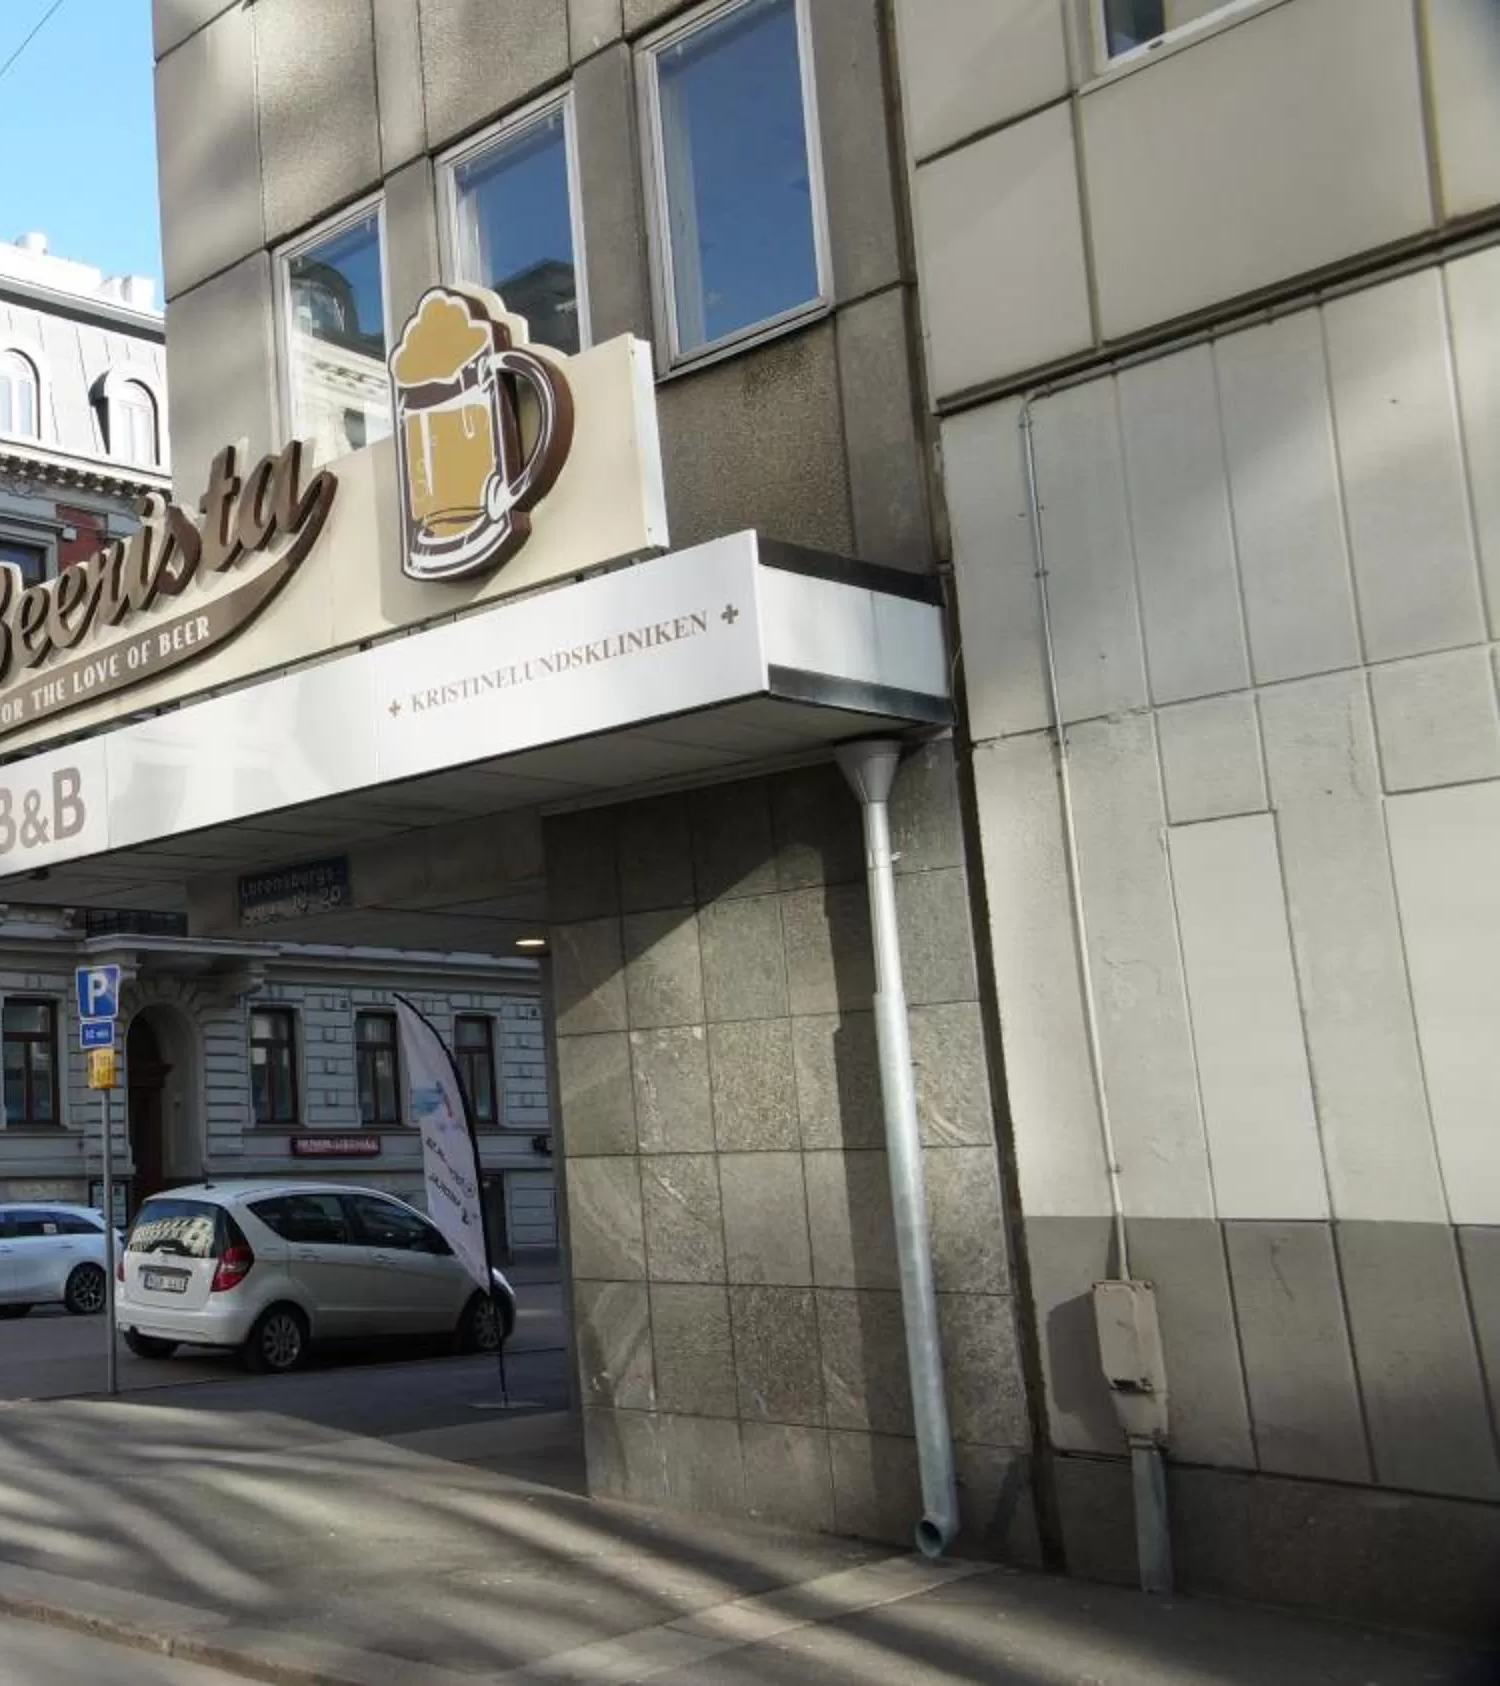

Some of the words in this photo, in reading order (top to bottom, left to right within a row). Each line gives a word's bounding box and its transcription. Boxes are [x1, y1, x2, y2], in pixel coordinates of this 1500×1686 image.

[32, 678, 67, 709] THE
[72, 656, 121, 693] LOVE
[127, 641, 151, 669] OF
[159, 616, 211, 656] BEER
[410, 610, 710, 714] KRISTINELUNDSKLINIKEN
[87, 971, 109, 1015] P
